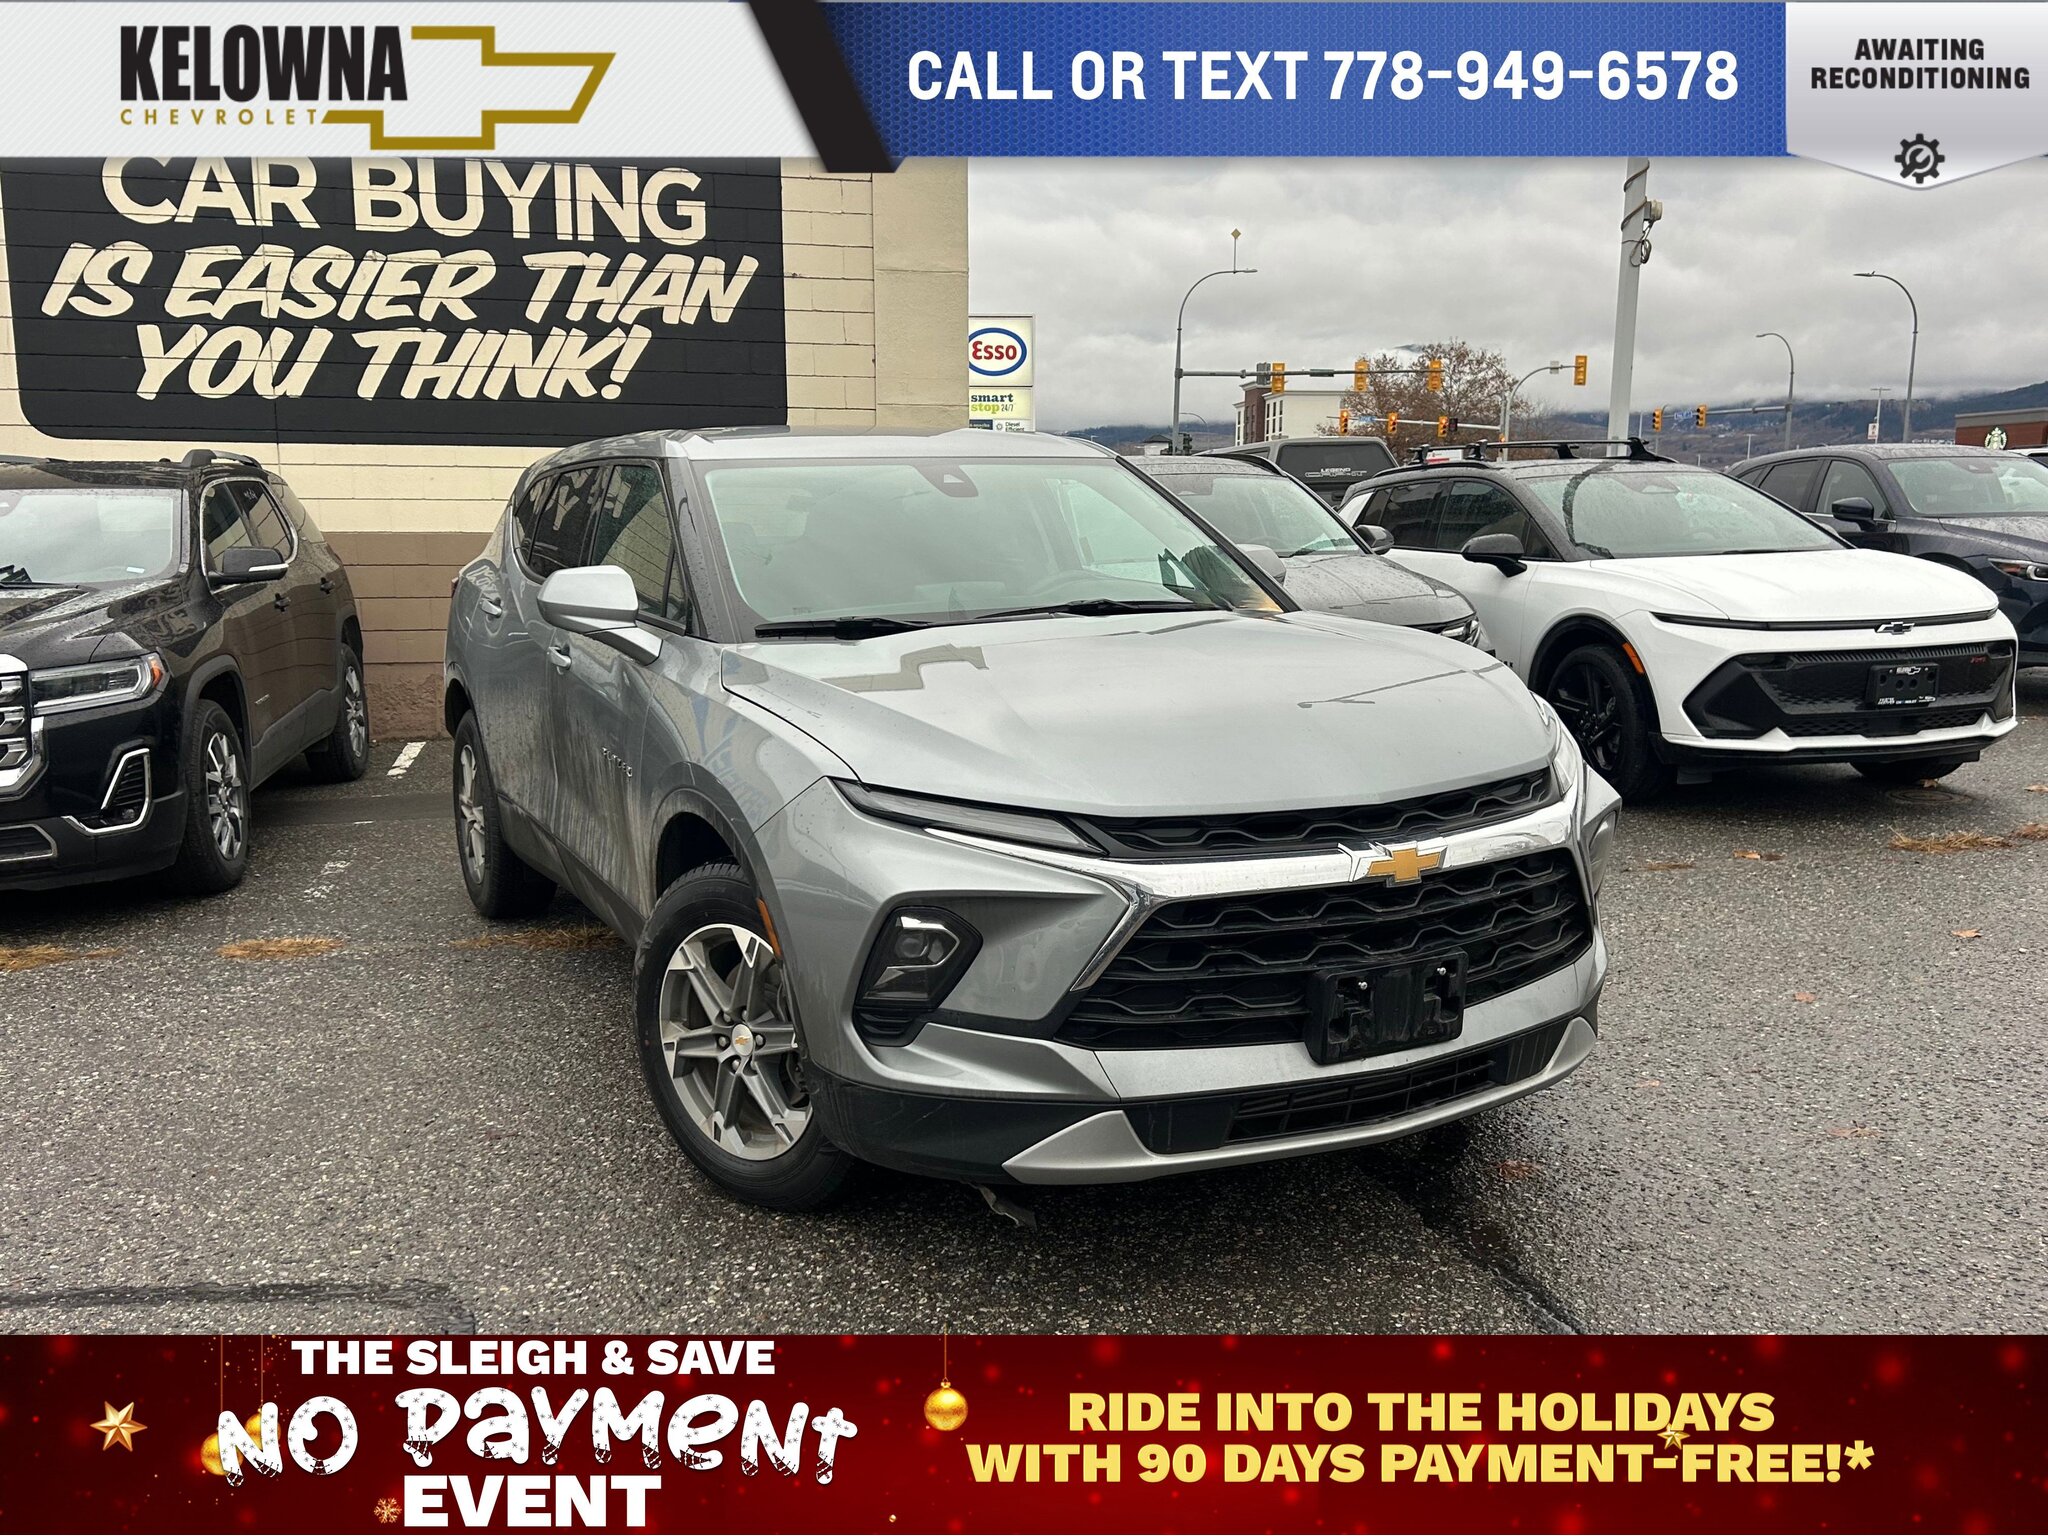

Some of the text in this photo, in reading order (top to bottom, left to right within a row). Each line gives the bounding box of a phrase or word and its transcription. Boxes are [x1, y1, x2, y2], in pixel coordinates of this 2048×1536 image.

[101, 157, 706, 246] CAR BUYING
[41, 240, 759, 325] IS EASIER THAN
[136, 324, 652, 401] YOU THINK!
[972, 340, 1017, 360] Esso
[970, 403, 1014, 414] stop 24/7
[971, 393, 1013, 403] smart
